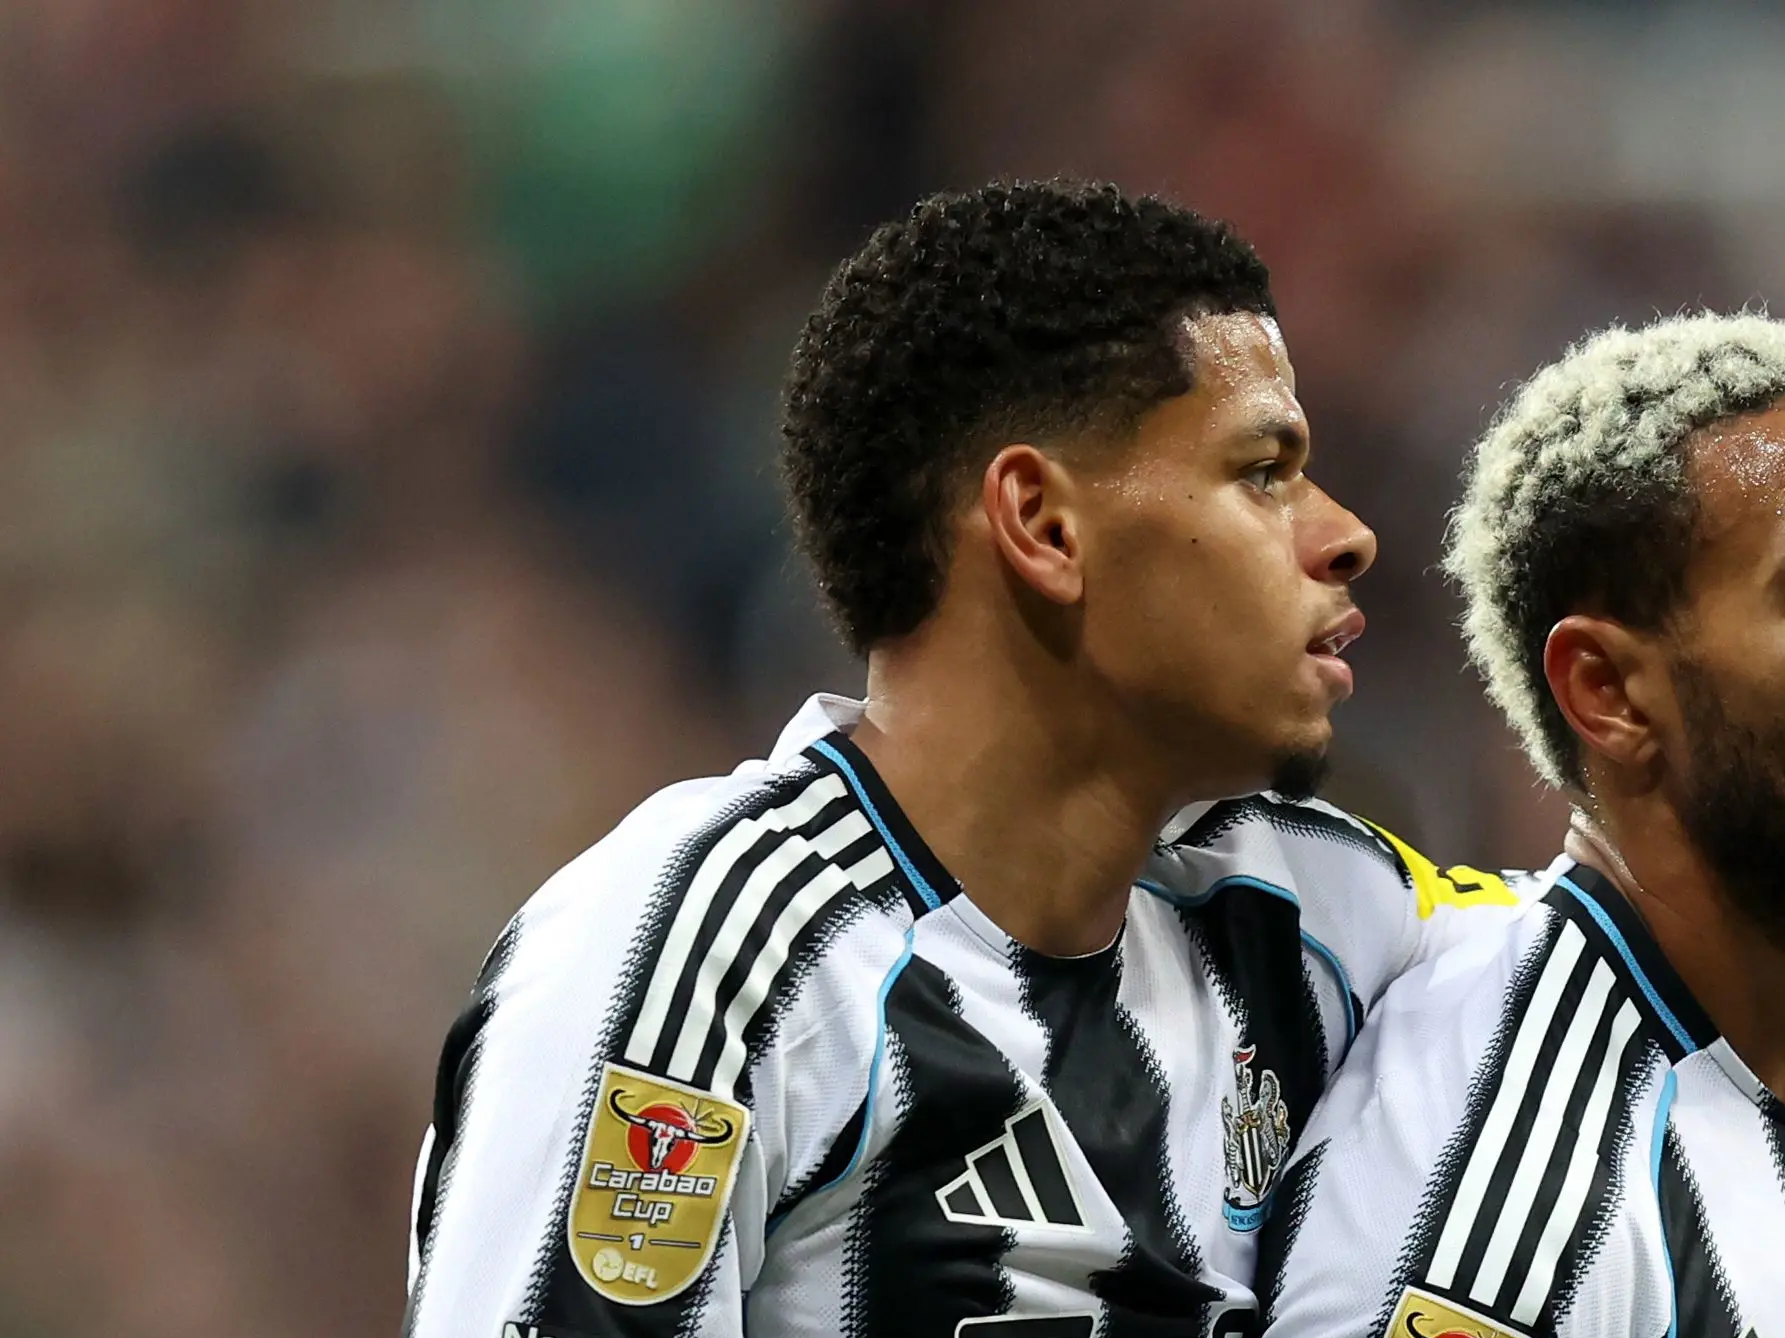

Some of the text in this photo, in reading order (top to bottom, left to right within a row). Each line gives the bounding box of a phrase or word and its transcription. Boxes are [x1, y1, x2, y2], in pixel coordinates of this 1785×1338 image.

[588, 1162, 717, 1196] Carabao
[611, 1193, 673, 1224] Cup
[623, 1261, 657, 1289] EFL
